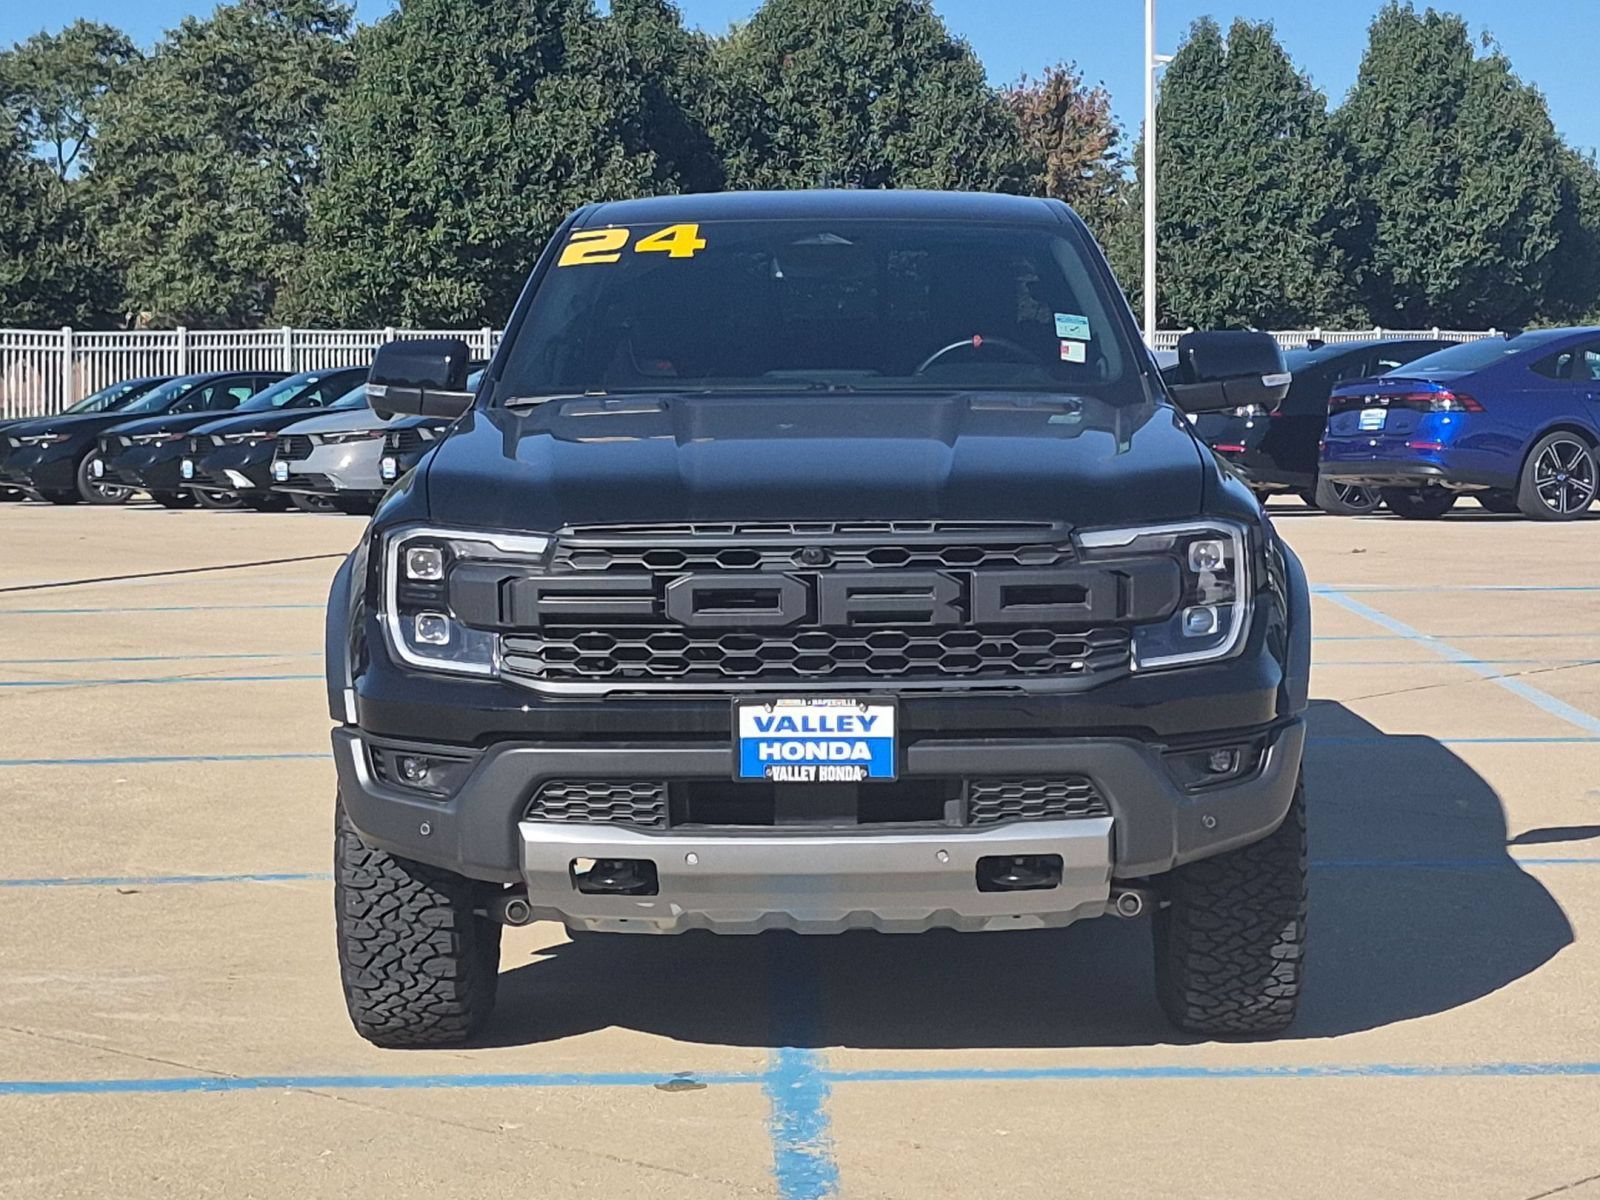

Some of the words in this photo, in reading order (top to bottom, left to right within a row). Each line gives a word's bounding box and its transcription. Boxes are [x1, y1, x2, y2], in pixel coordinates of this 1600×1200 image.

[557, 223, 707, 267] 24
[502, 571, 1120, 628] FORD
[753, 715, 879, 733] VALLEY
[758, 741, 873, 761] HONDA
[771, 765, 817, 782] VALLEY
[818, 765, 863, 782] HONDA
